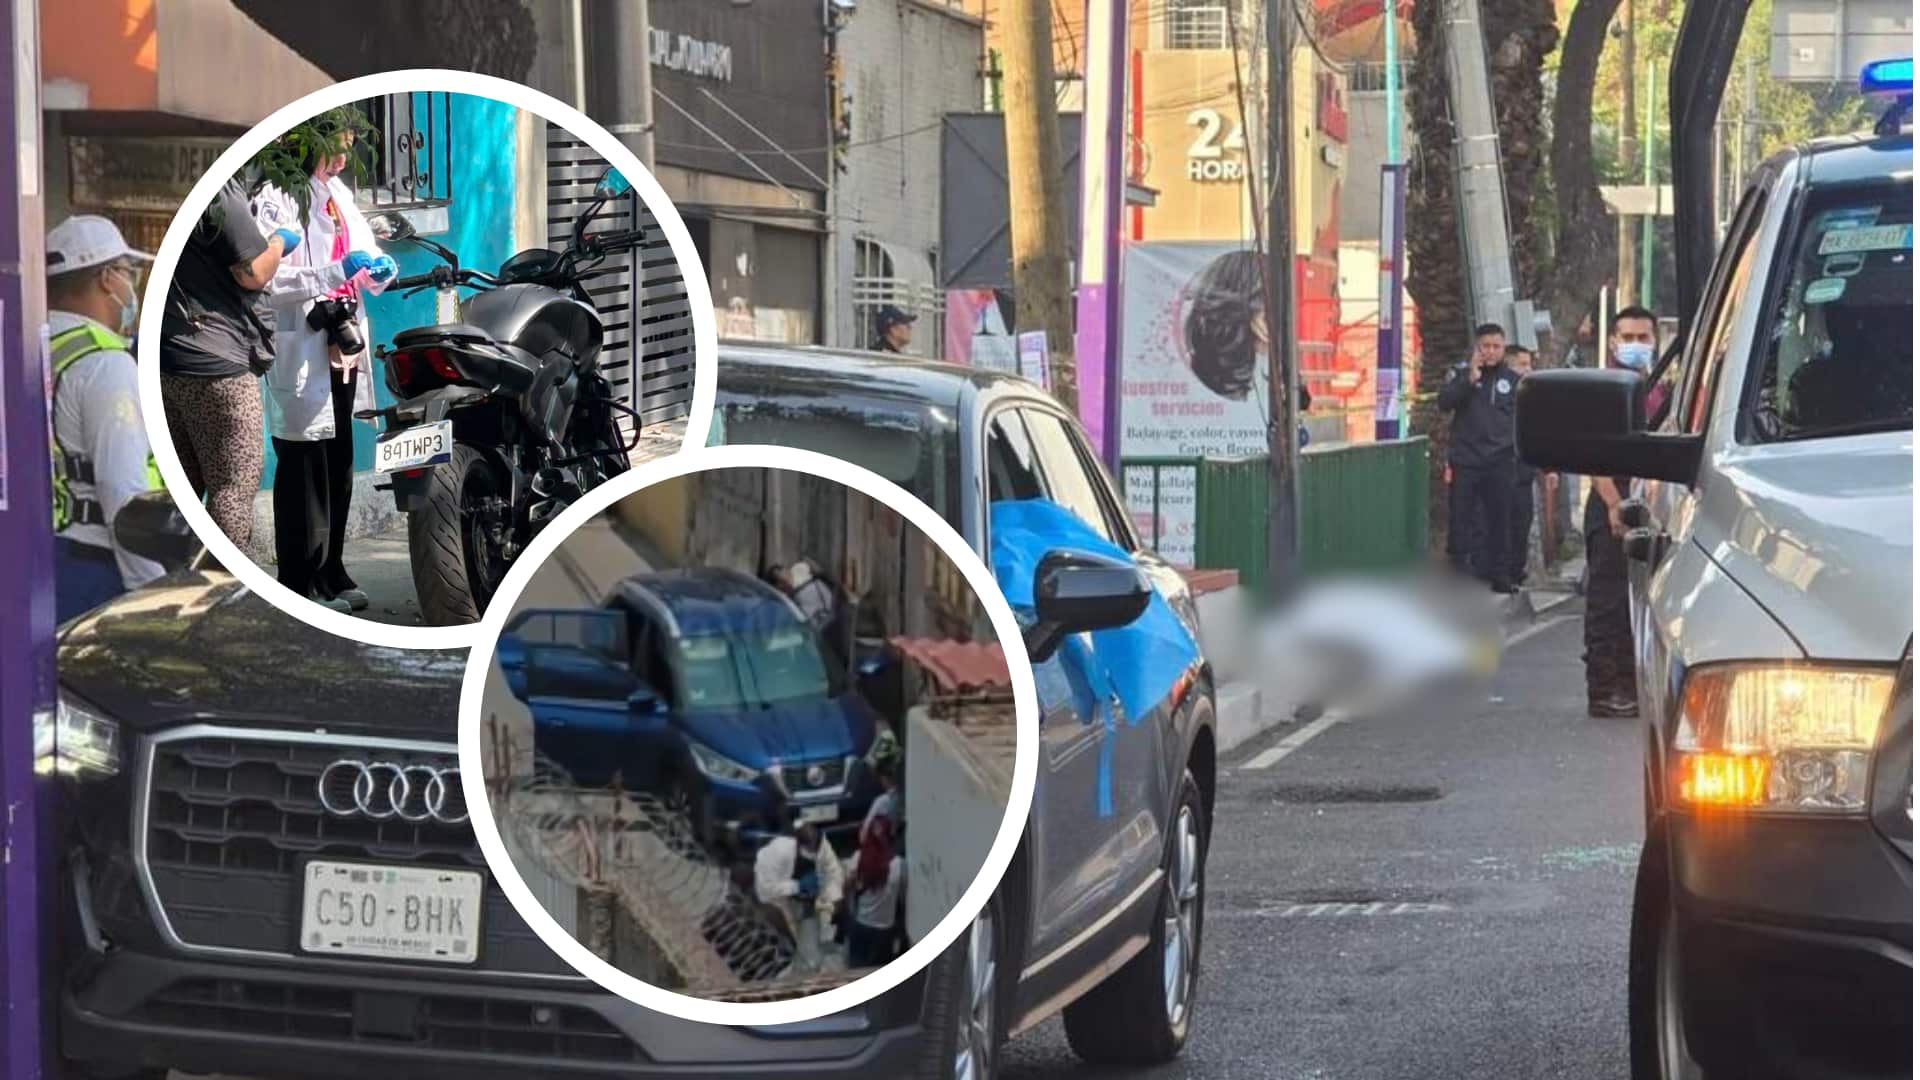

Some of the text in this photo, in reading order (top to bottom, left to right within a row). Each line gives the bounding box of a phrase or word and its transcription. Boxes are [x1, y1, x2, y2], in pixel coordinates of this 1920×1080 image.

[1186, 108, 1244, 157] 24
[1151, 401, 1225, 416] servicios
[383, 435, 443, 461] 84TWP3
[316, 888, 464, 936] C50-BHK
